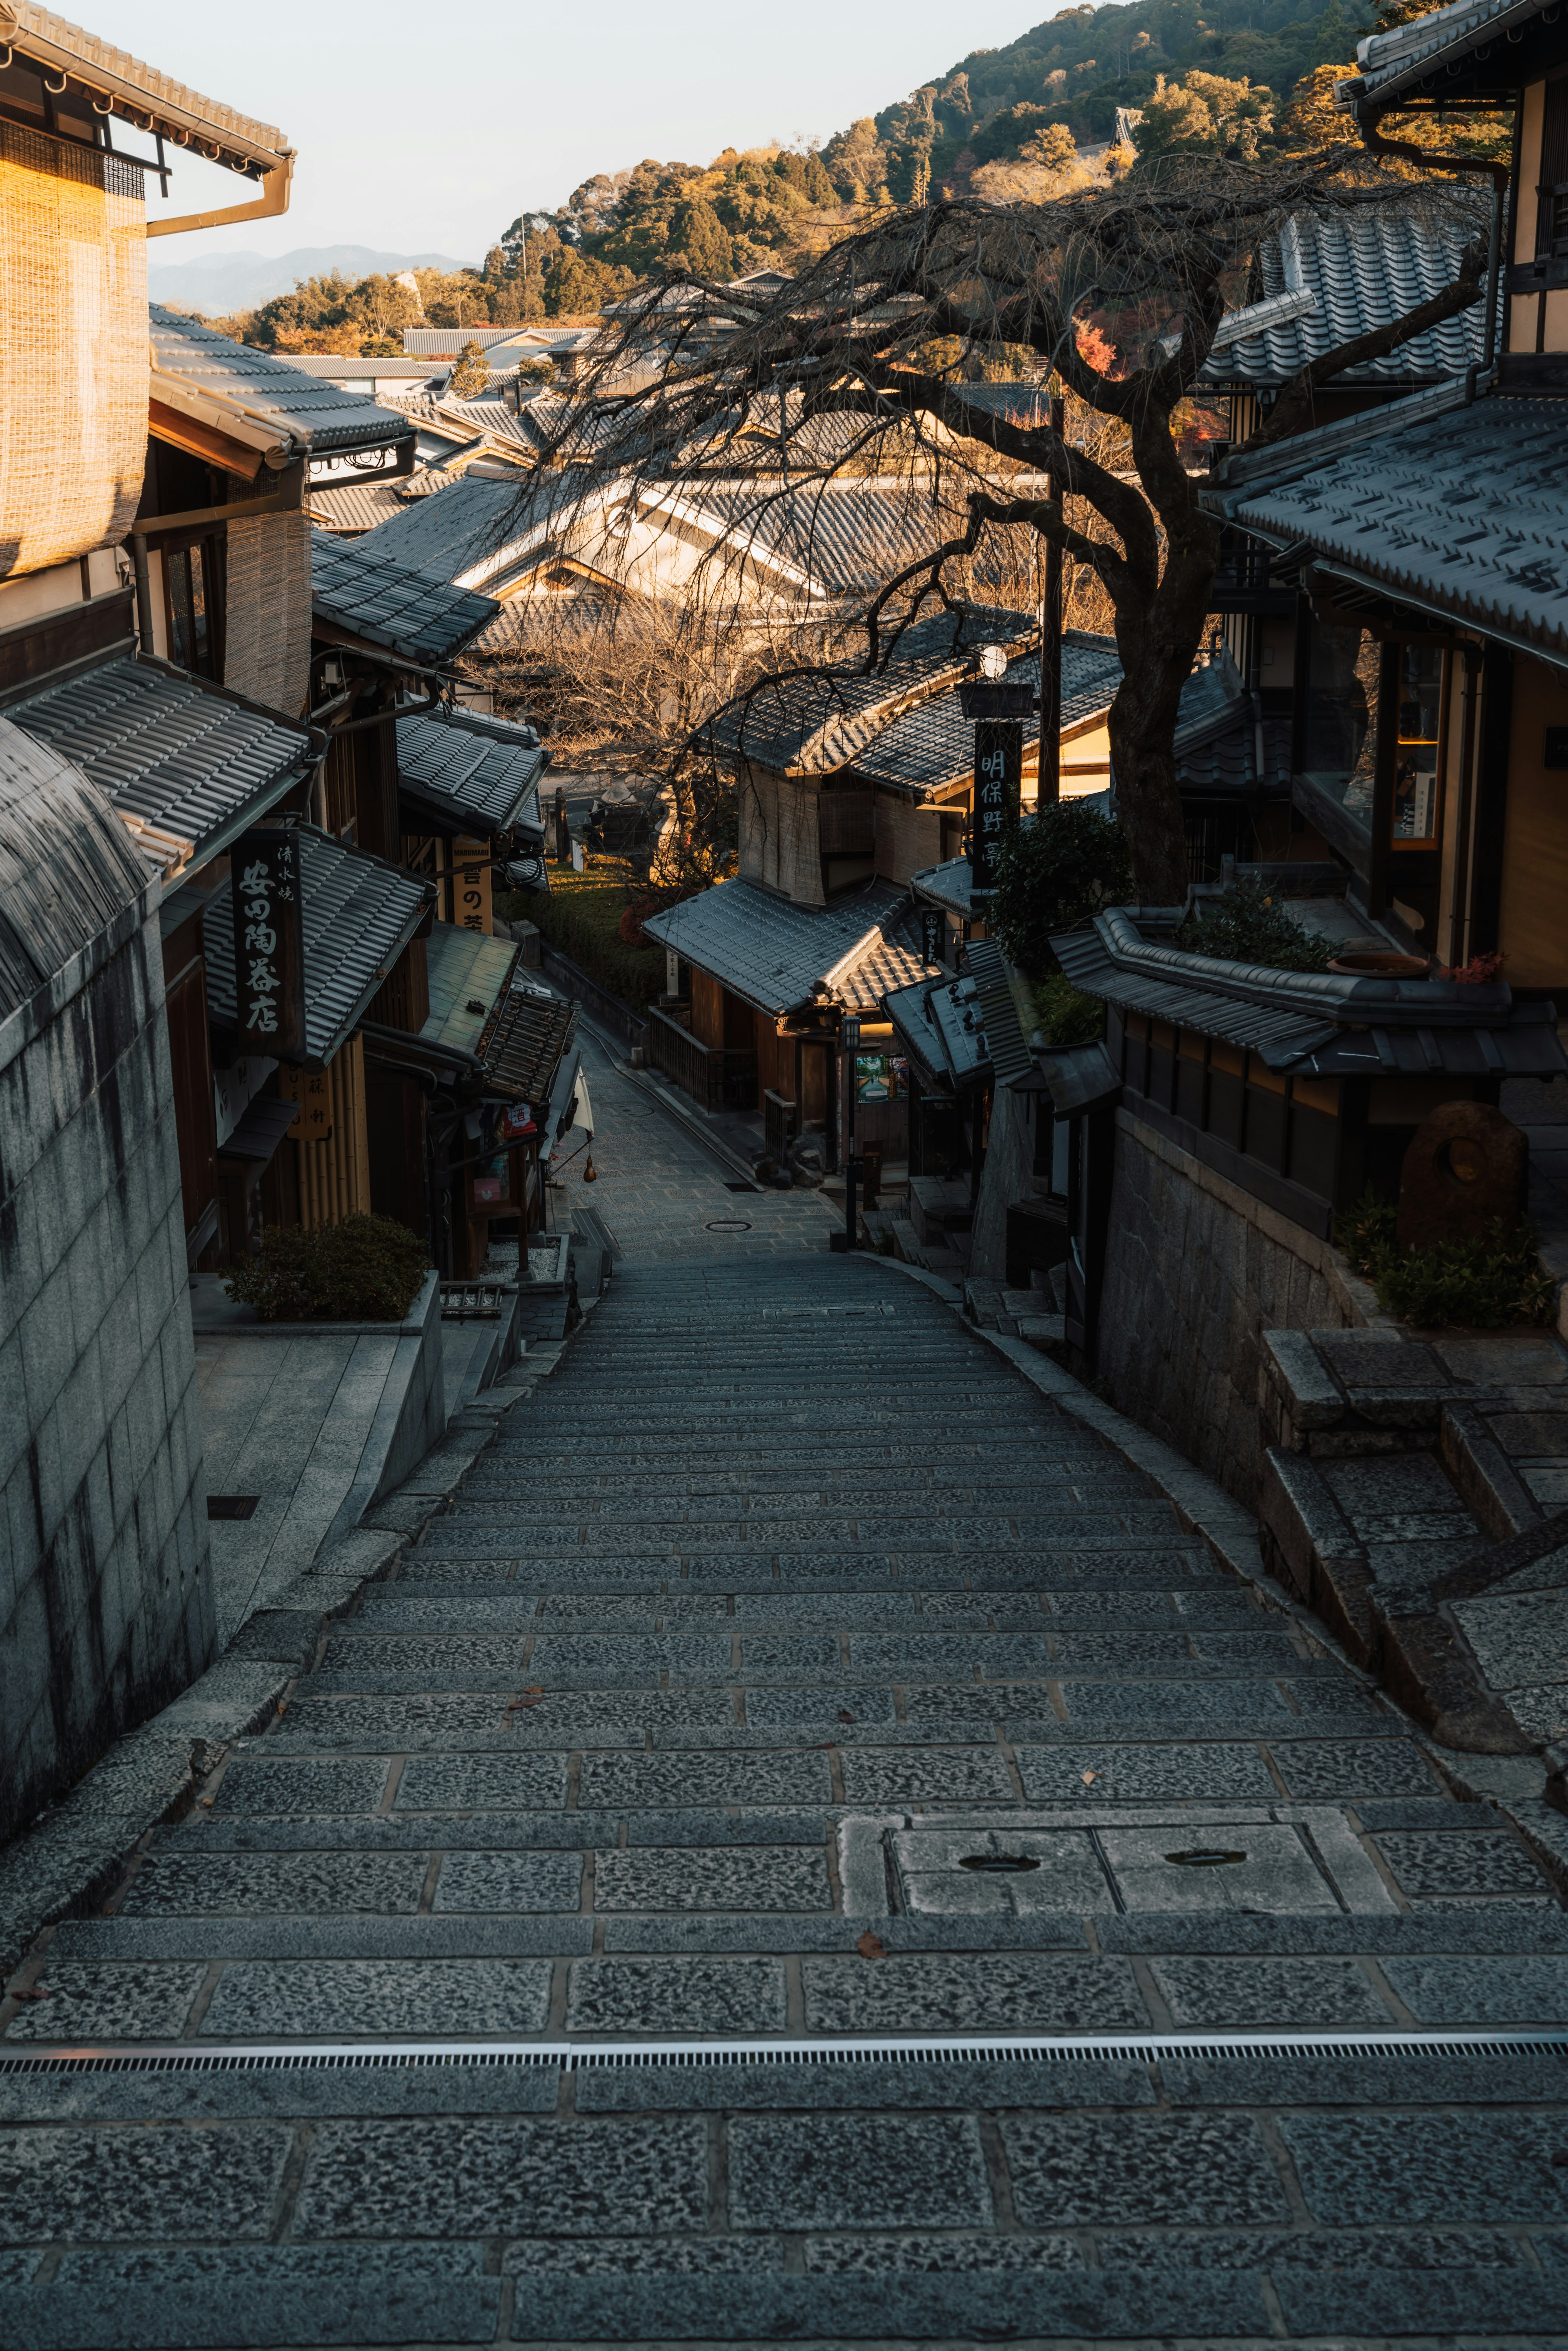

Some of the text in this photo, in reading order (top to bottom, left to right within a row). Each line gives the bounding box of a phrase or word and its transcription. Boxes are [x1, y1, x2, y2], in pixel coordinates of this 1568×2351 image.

[981, 750, 1005, 867] 明保野亭
[278, 846, 296, 901] 清水焼
[239, 859, 281, 1032] 安田陶器店
